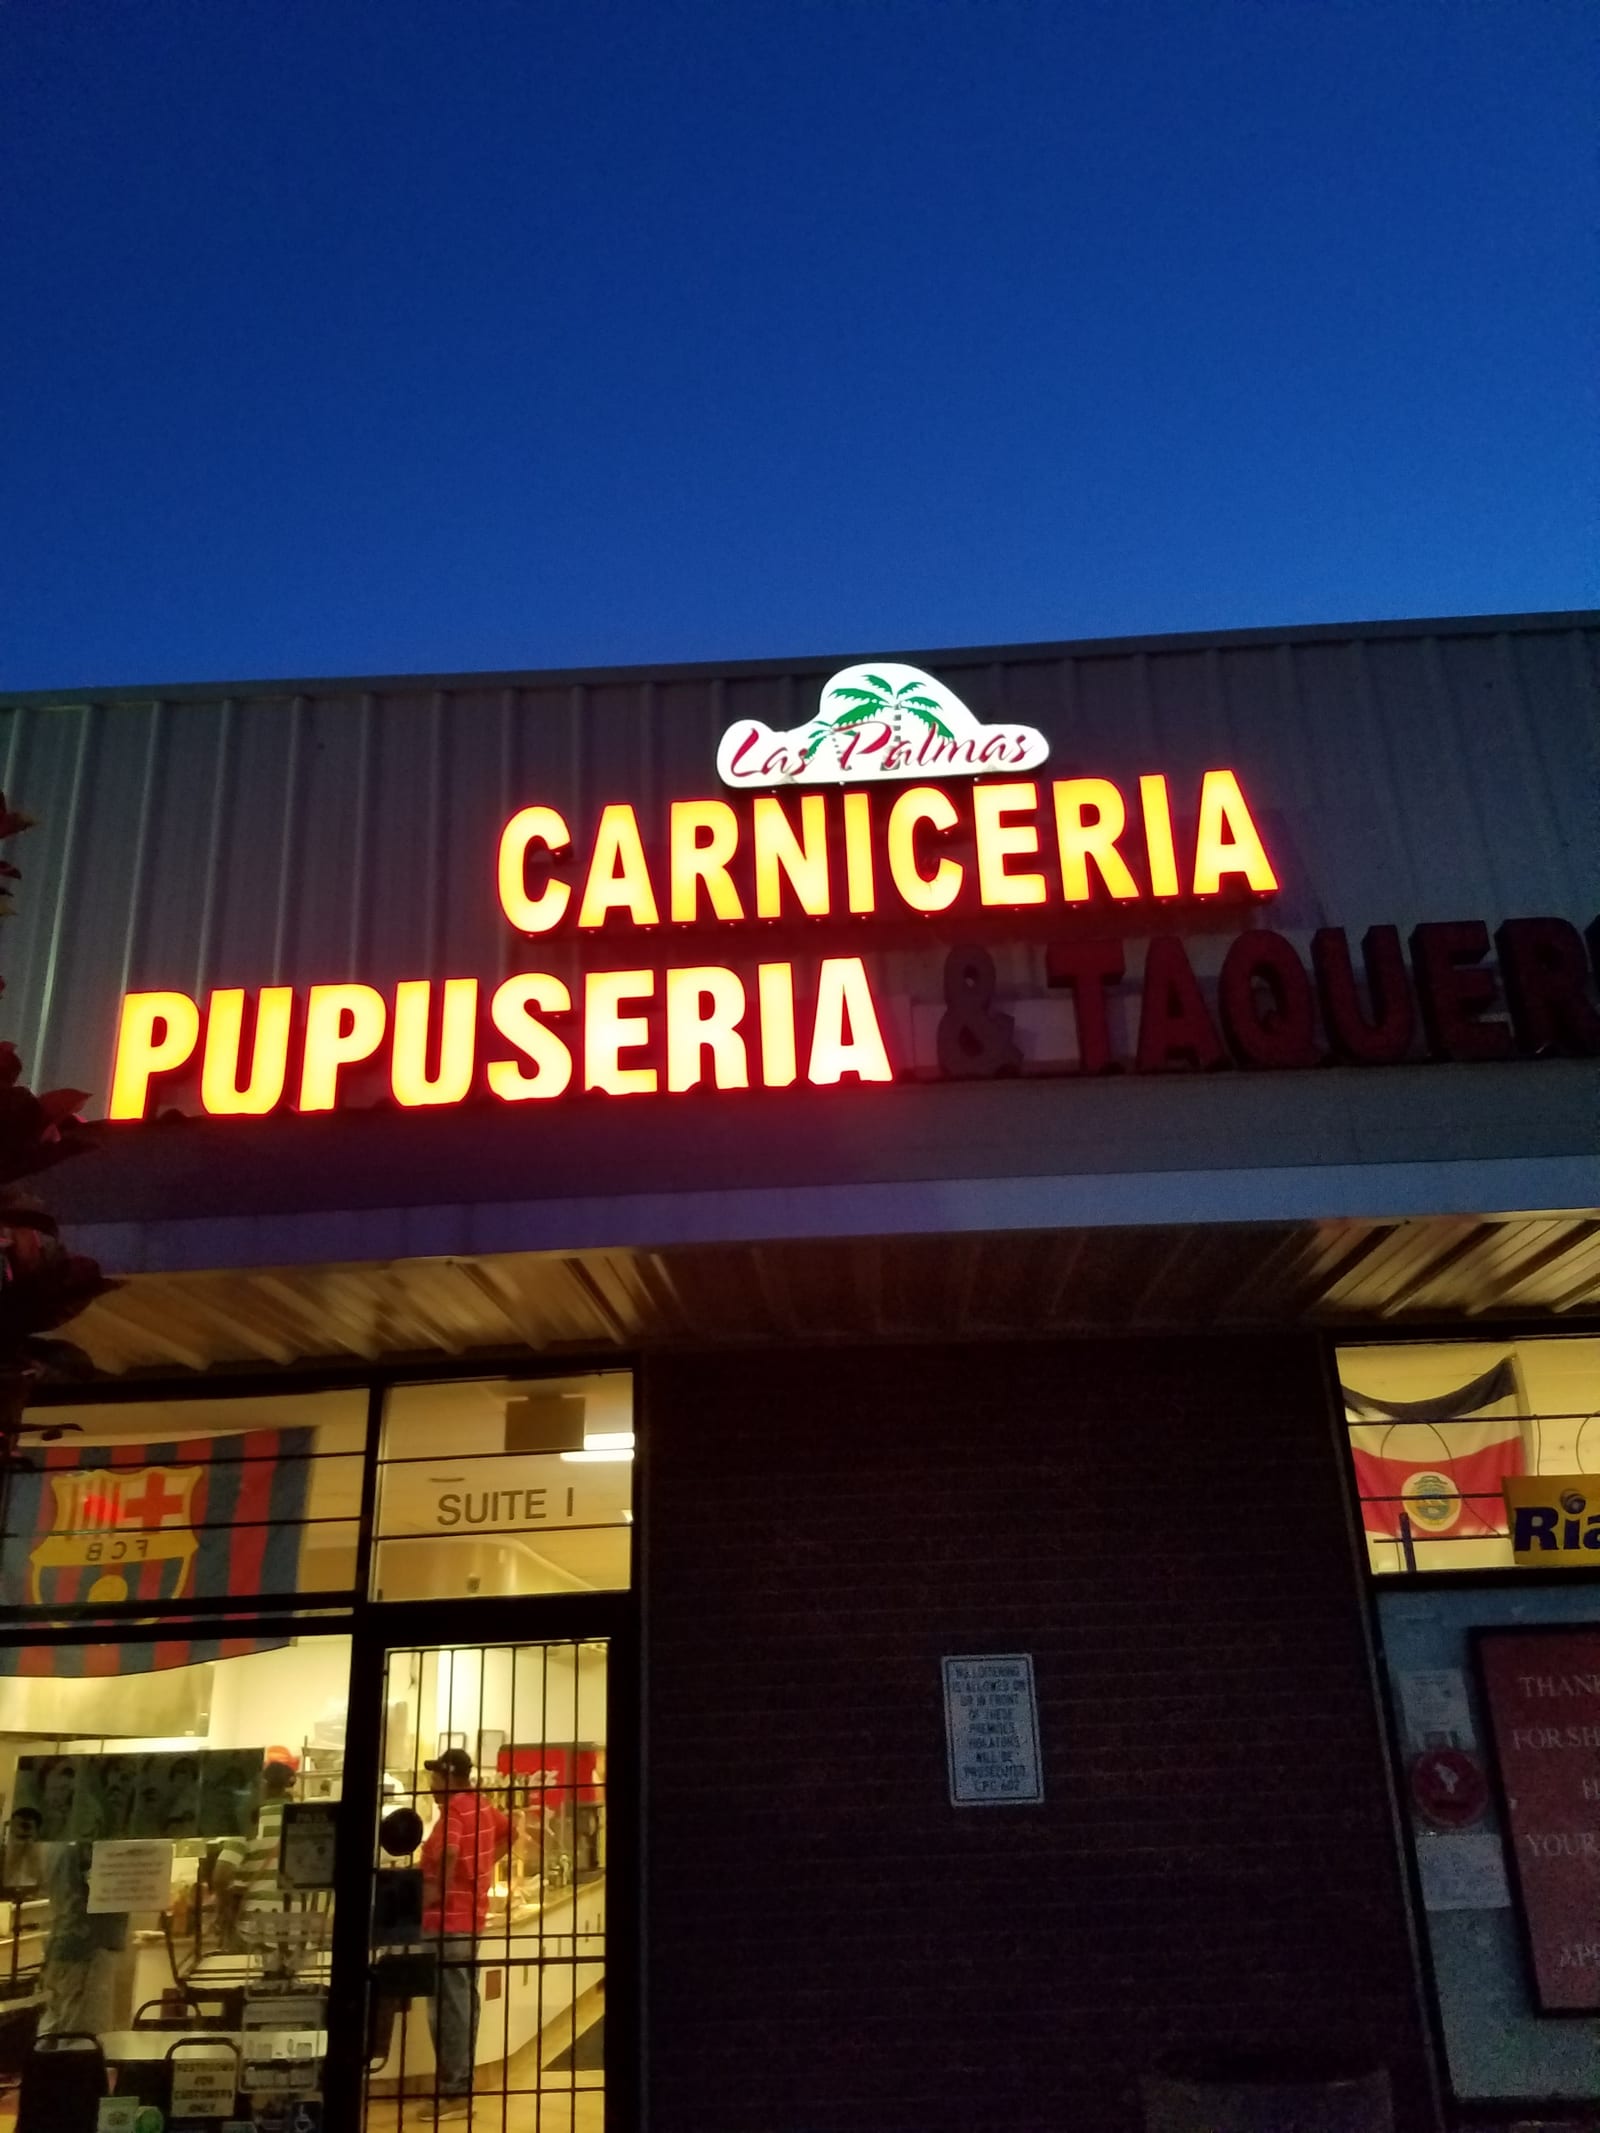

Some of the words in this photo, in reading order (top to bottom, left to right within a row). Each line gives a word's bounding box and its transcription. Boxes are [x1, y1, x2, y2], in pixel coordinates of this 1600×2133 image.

[729, 727, 809, 777] Las
[831, 720, 1034, 770] Palmas
[497, 768, 1280, 934] CARNICERIA
[108, 956, 894, 1121] PUPUSERIA
[935, 942, 1020, 1077] &
[436, 1488, 547, 1526] SUITE
[1512, 1726, 1563, 1750] FOR
[1525, 1831, 1600, 1857] YOUR
